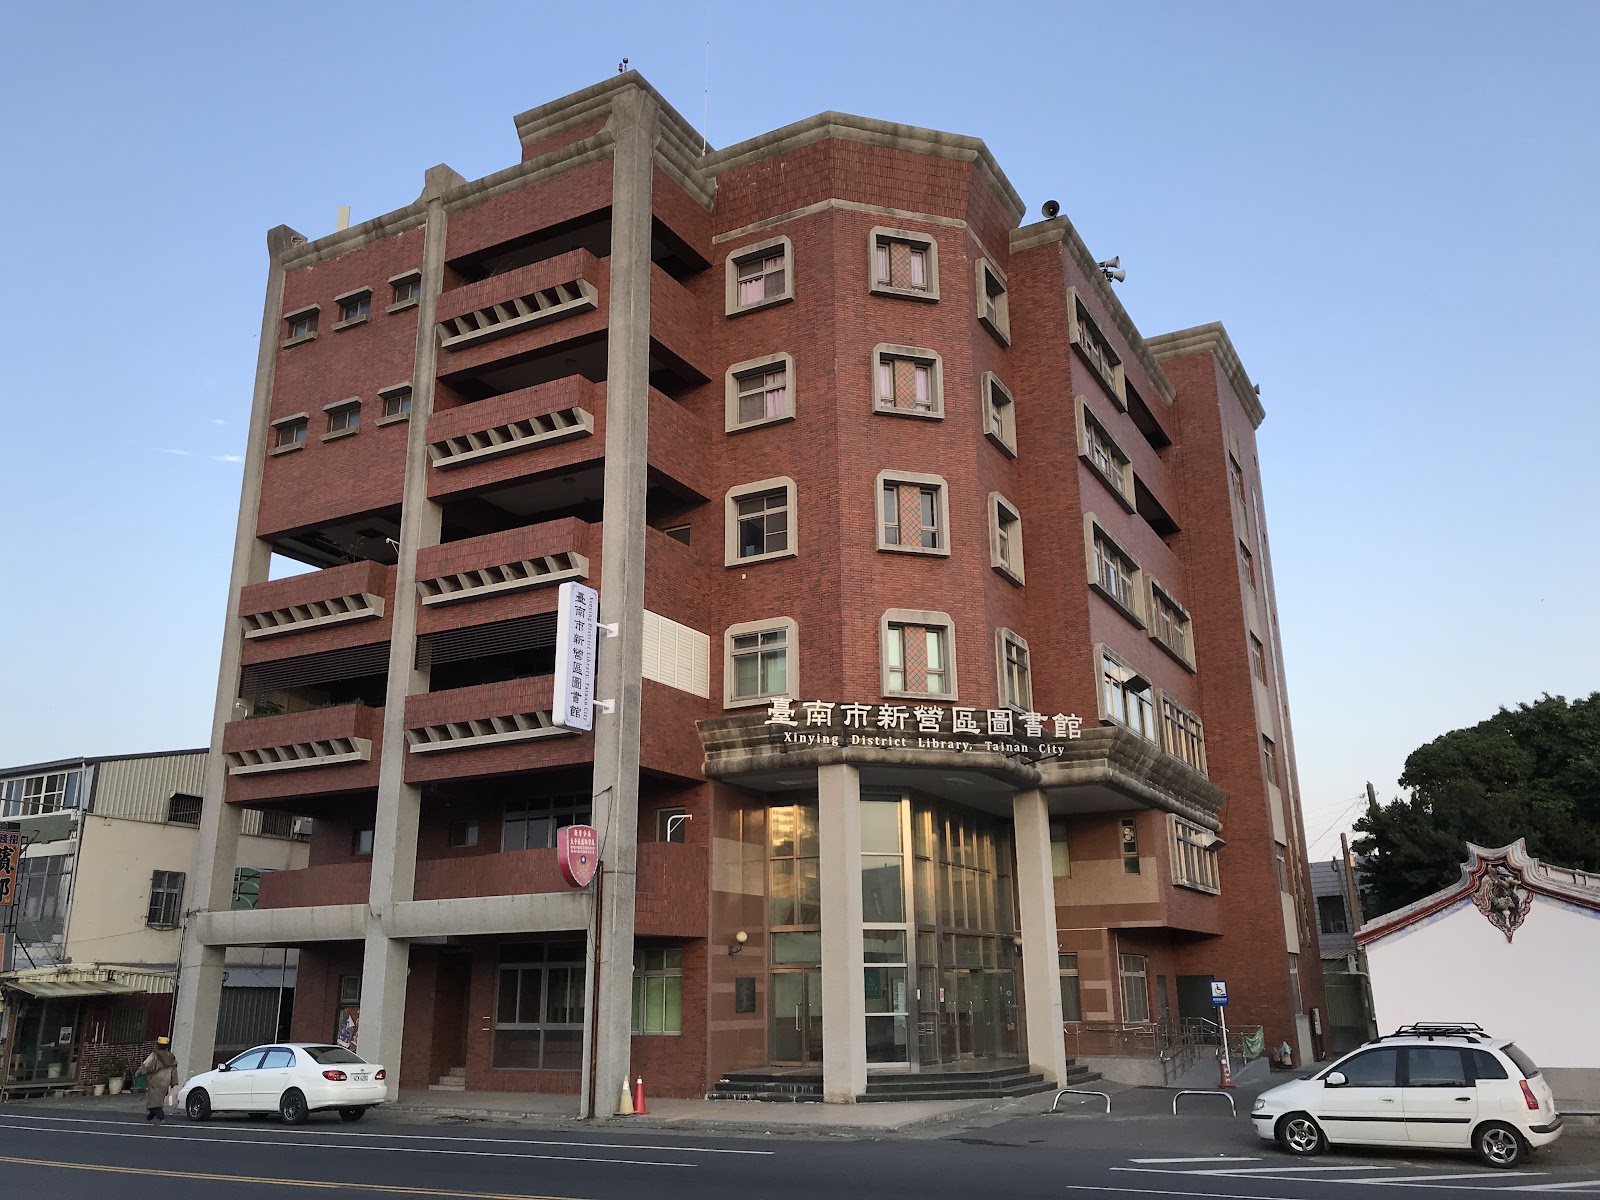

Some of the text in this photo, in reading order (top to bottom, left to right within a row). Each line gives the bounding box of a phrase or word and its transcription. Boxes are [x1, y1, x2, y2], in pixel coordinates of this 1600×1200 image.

[570, 591, 587, 719] 臺南市新營區圖書館
[764, 697, 1083, 739] 臺南市新營區圖書館
[783, 731, 1065, 757] Xinying District Library, Tainan City
